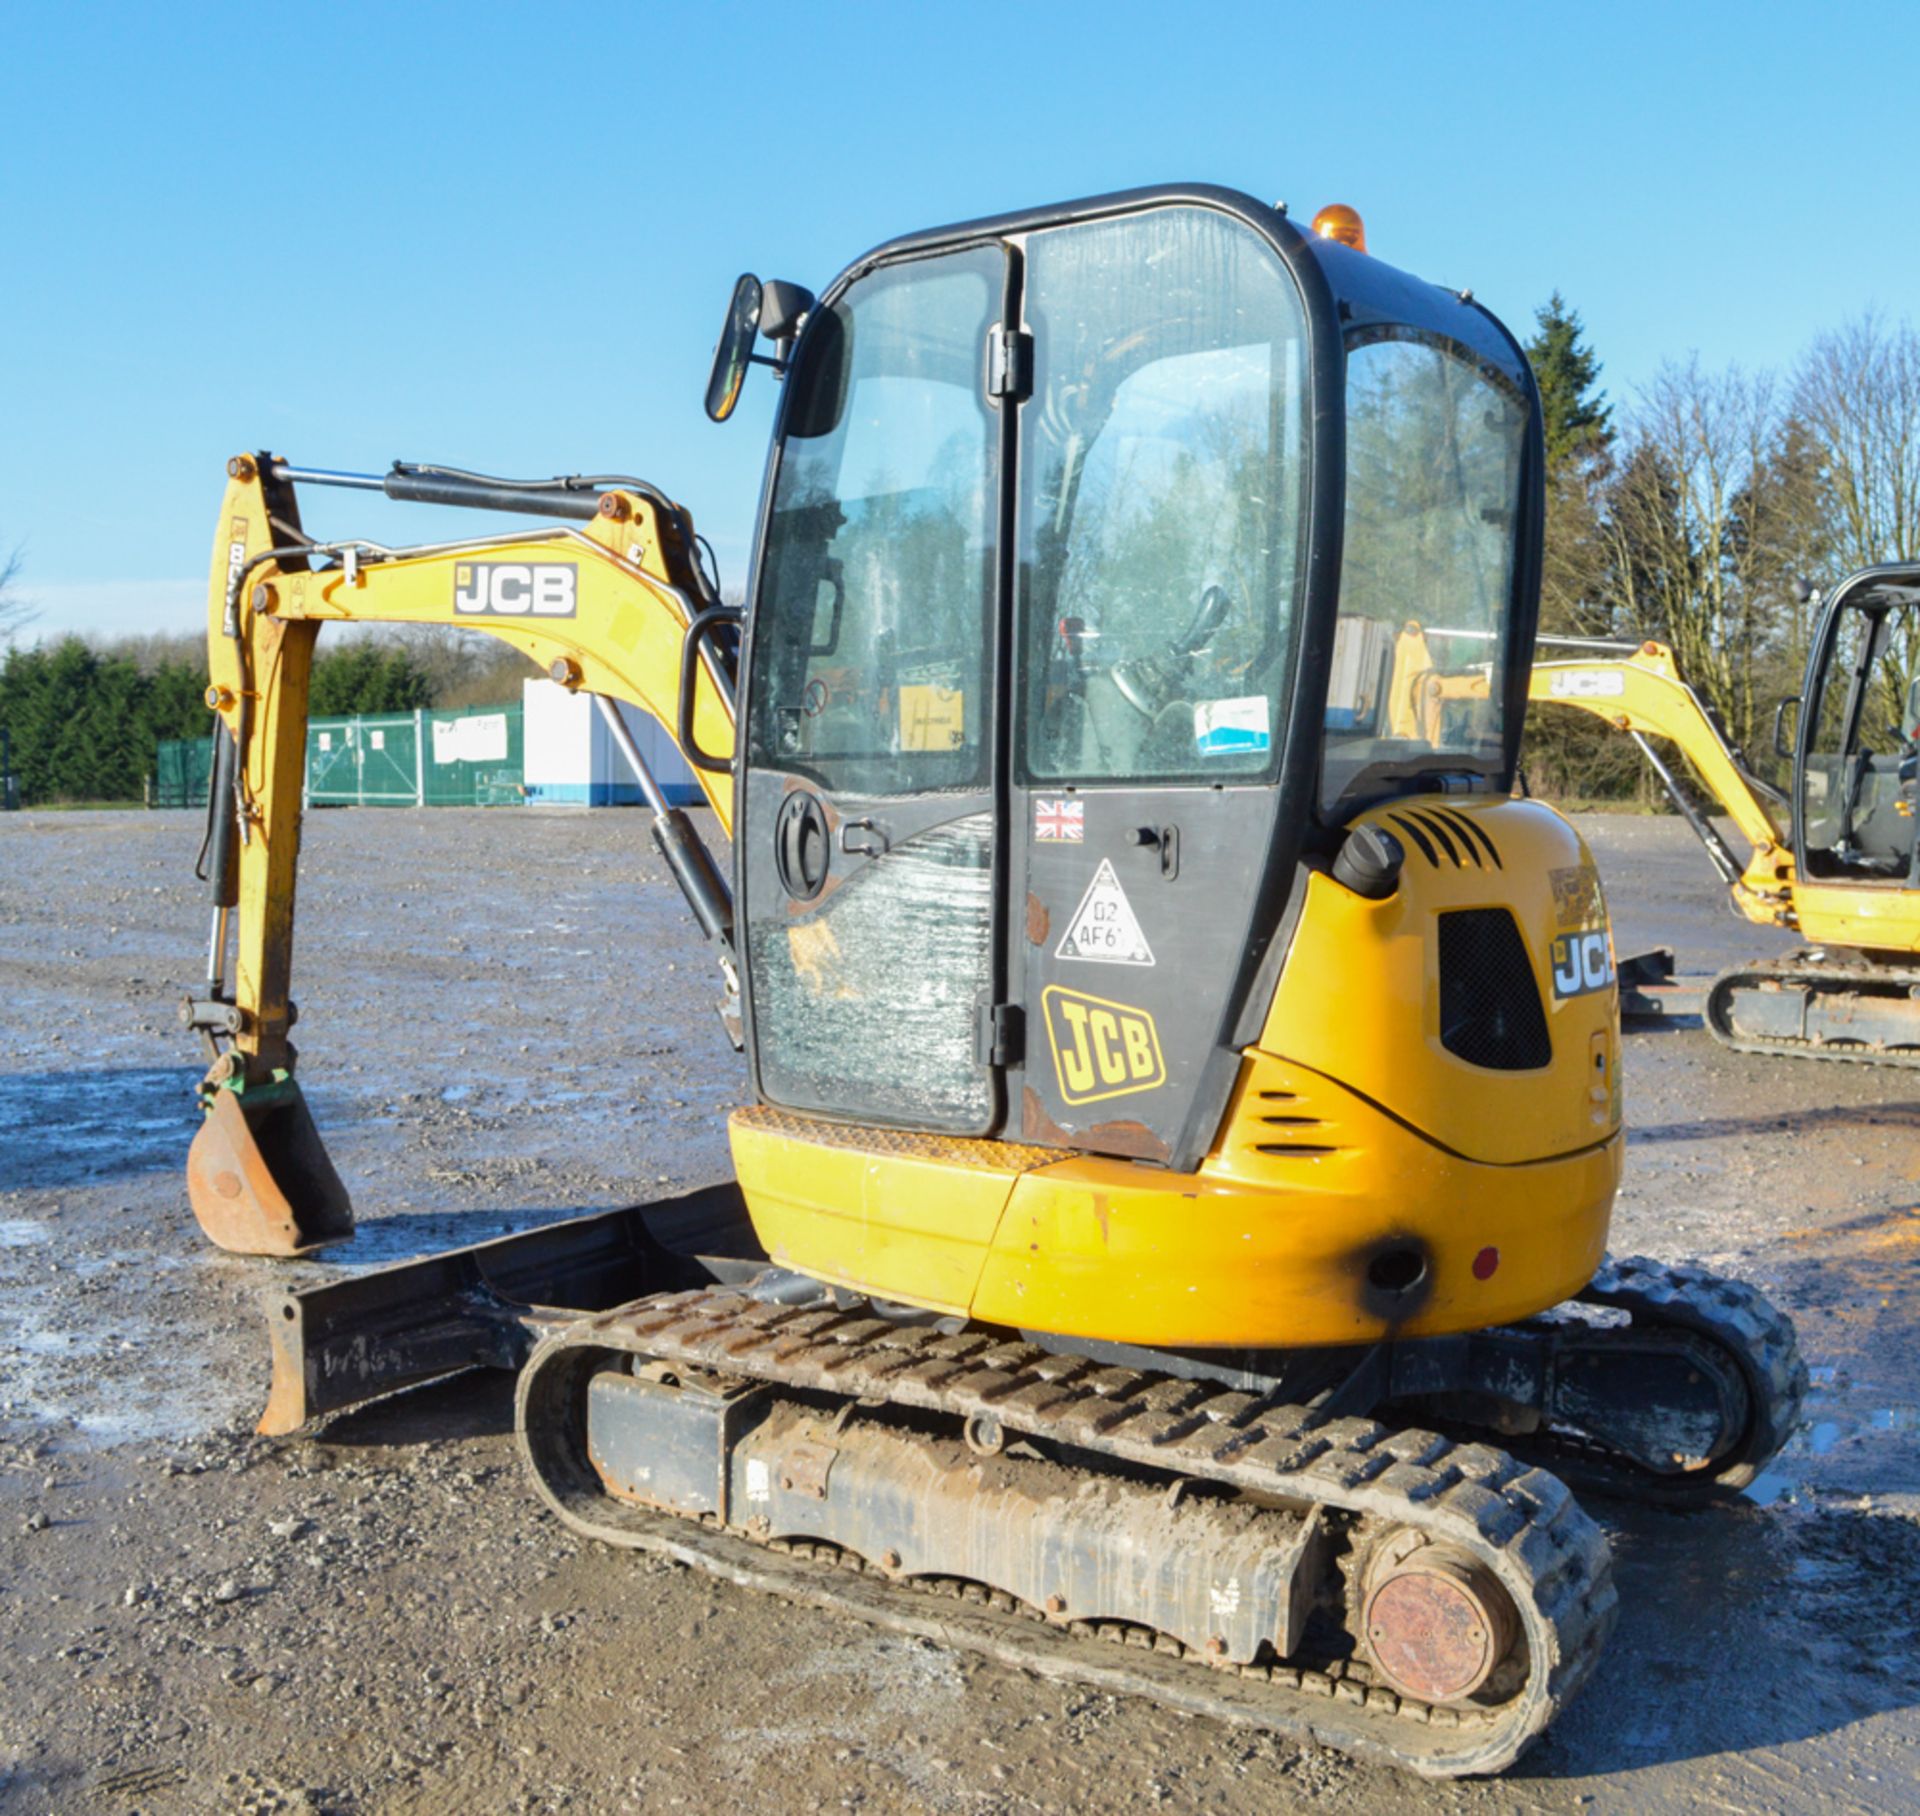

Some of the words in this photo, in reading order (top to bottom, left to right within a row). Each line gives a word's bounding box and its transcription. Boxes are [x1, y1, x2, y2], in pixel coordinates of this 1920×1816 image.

[456, 565, 575, 613] JCB
[1079, 925, 1122, 947] AF6
[1060, 1000, 1155, 1092] JCB
